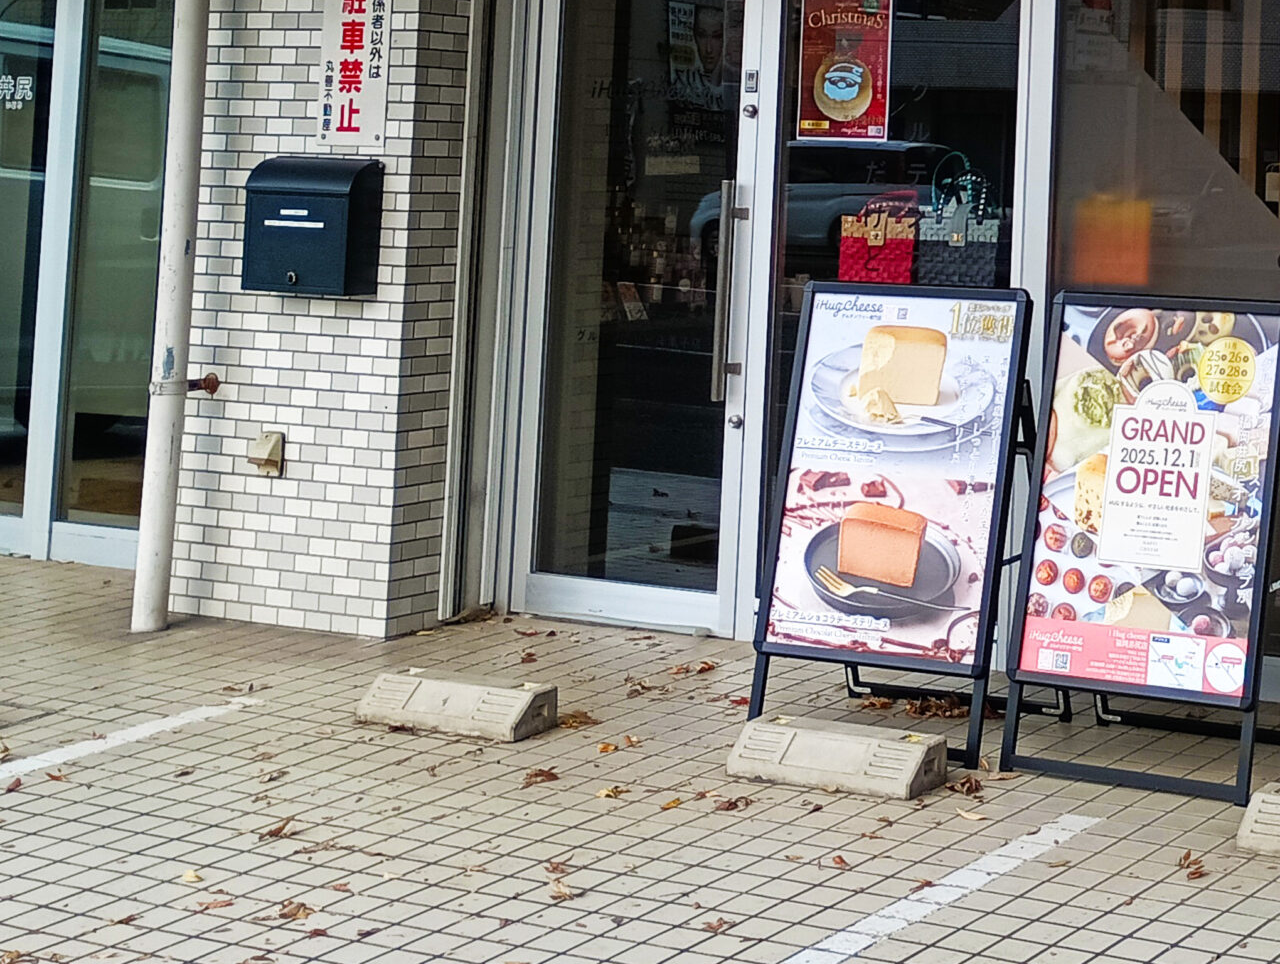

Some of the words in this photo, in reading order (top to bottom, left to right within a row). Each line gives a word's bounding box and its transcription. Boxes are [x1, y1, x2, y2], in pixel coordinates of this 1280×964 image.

[1121, 416, 1206, 445] GRAND
[1120, 447, 1196, 468] 2025.12.1
[1116, 466, 1200, 500] OPEN
